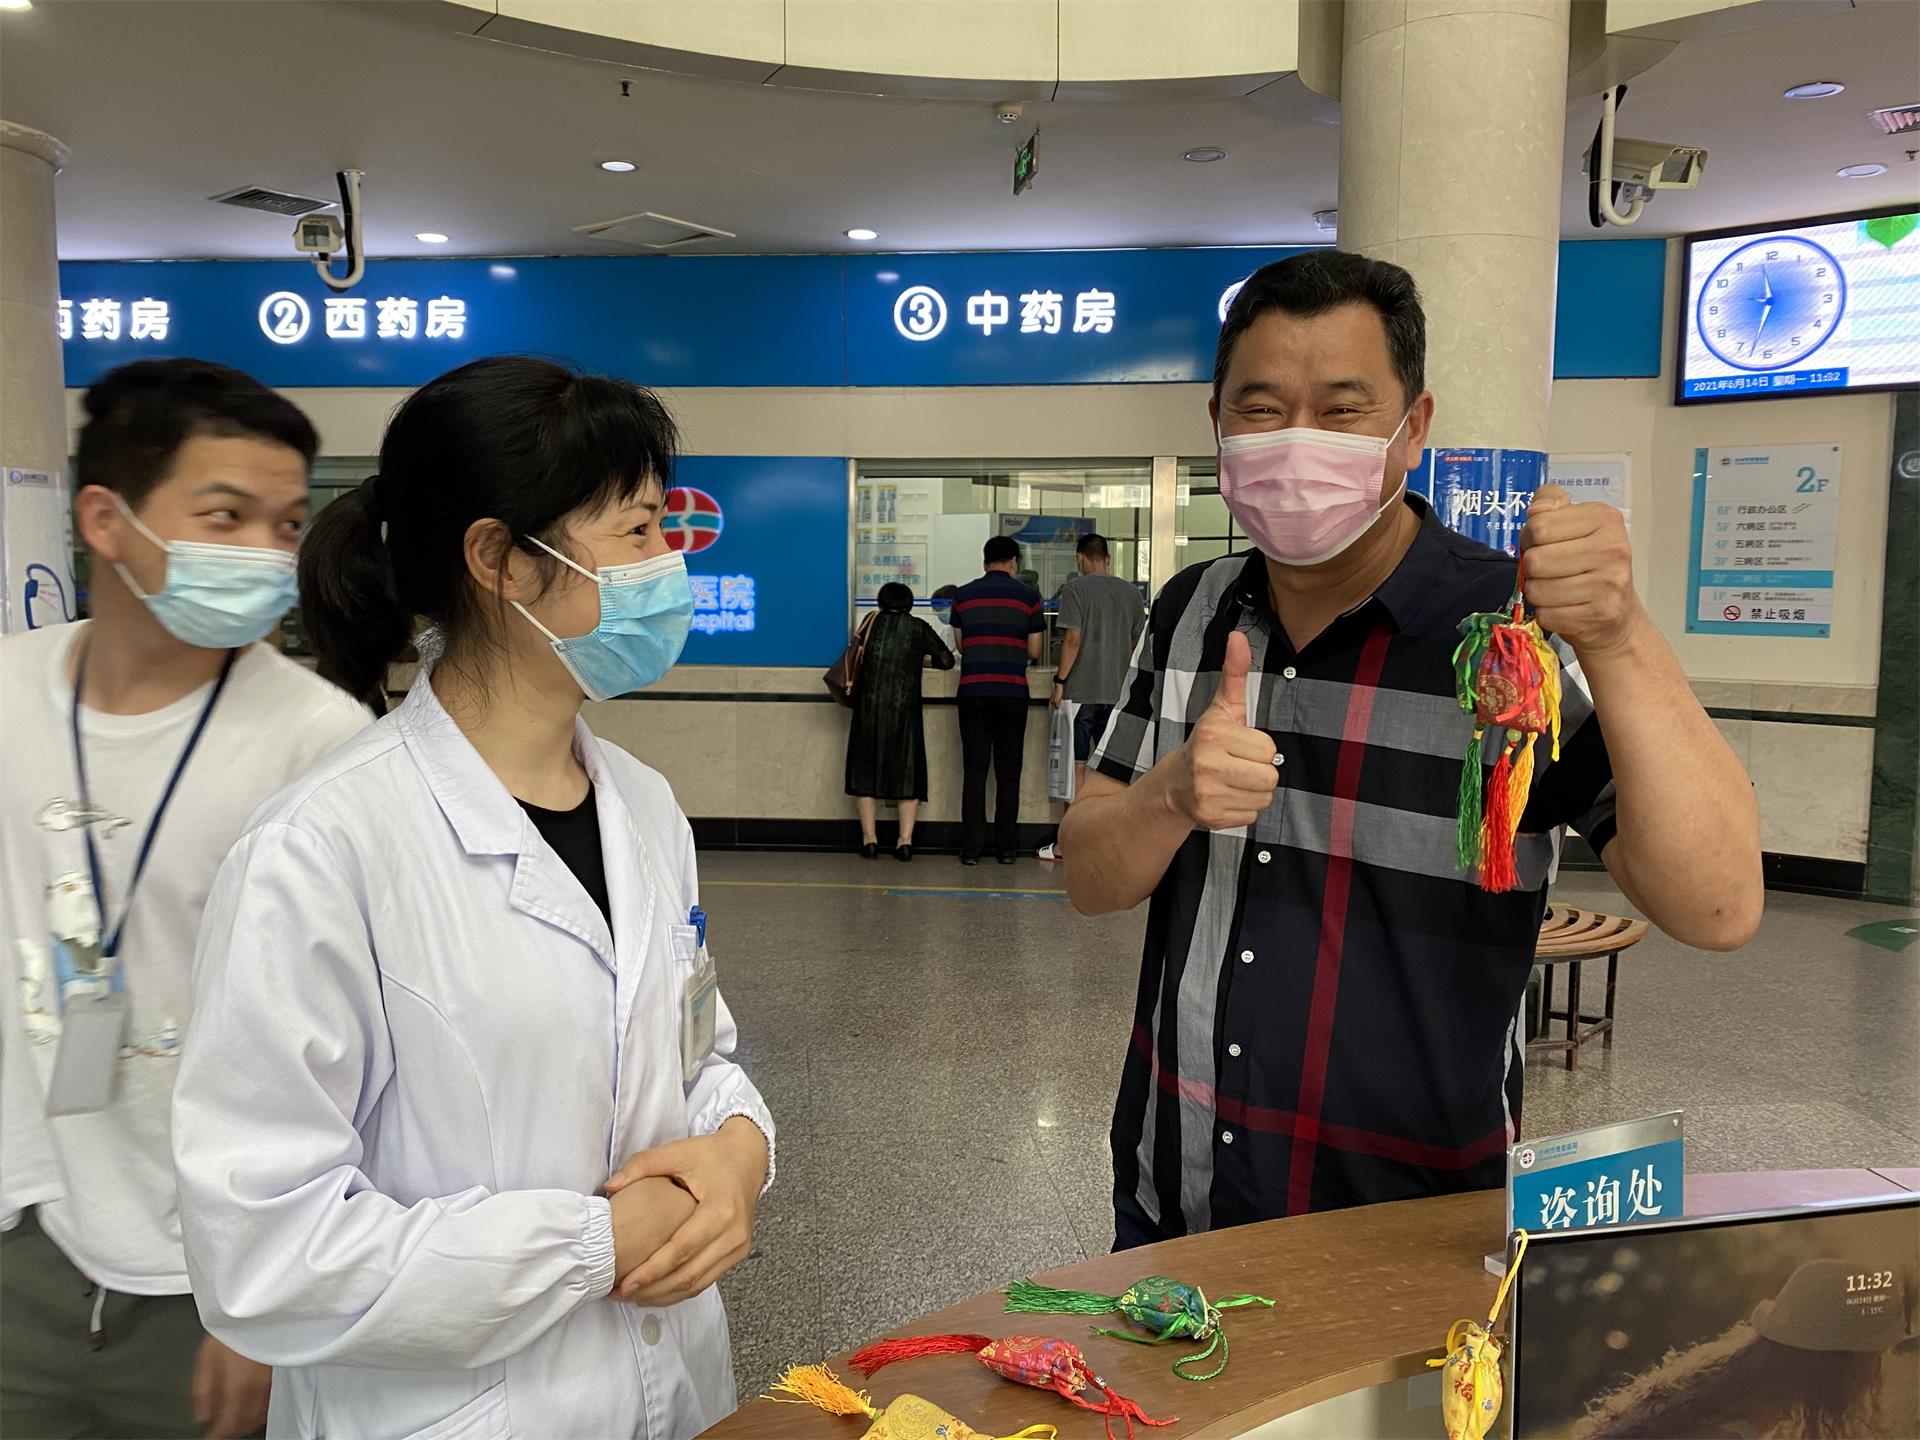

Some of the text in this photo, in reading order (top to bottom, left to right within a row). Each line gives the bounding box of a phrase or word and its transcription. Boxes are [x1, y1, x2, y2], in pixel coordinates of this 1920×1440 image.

[325, 295, 467, 339] 西药房
[966, 287, 1117, 336] 中药房
[1693, 377, 1768, 391] 2021年6月14日
[1796, 465, 1829, 493] 2F
[1737, 504, 1787, 514] 行政办公区
[1736, 522, 1766, 532] 六病区
[1735, 539, 1764, 549] 五病区
[1734, 557, 1764, 566] 三病区
[1732, 591, 1761, 601] 一病区
[1750, 608, 1806, 621] 禁止吸烟
[1539, 1164, 1663, 1230] 咨询处
[1846, 1271, 1893, 1292] 11:32
